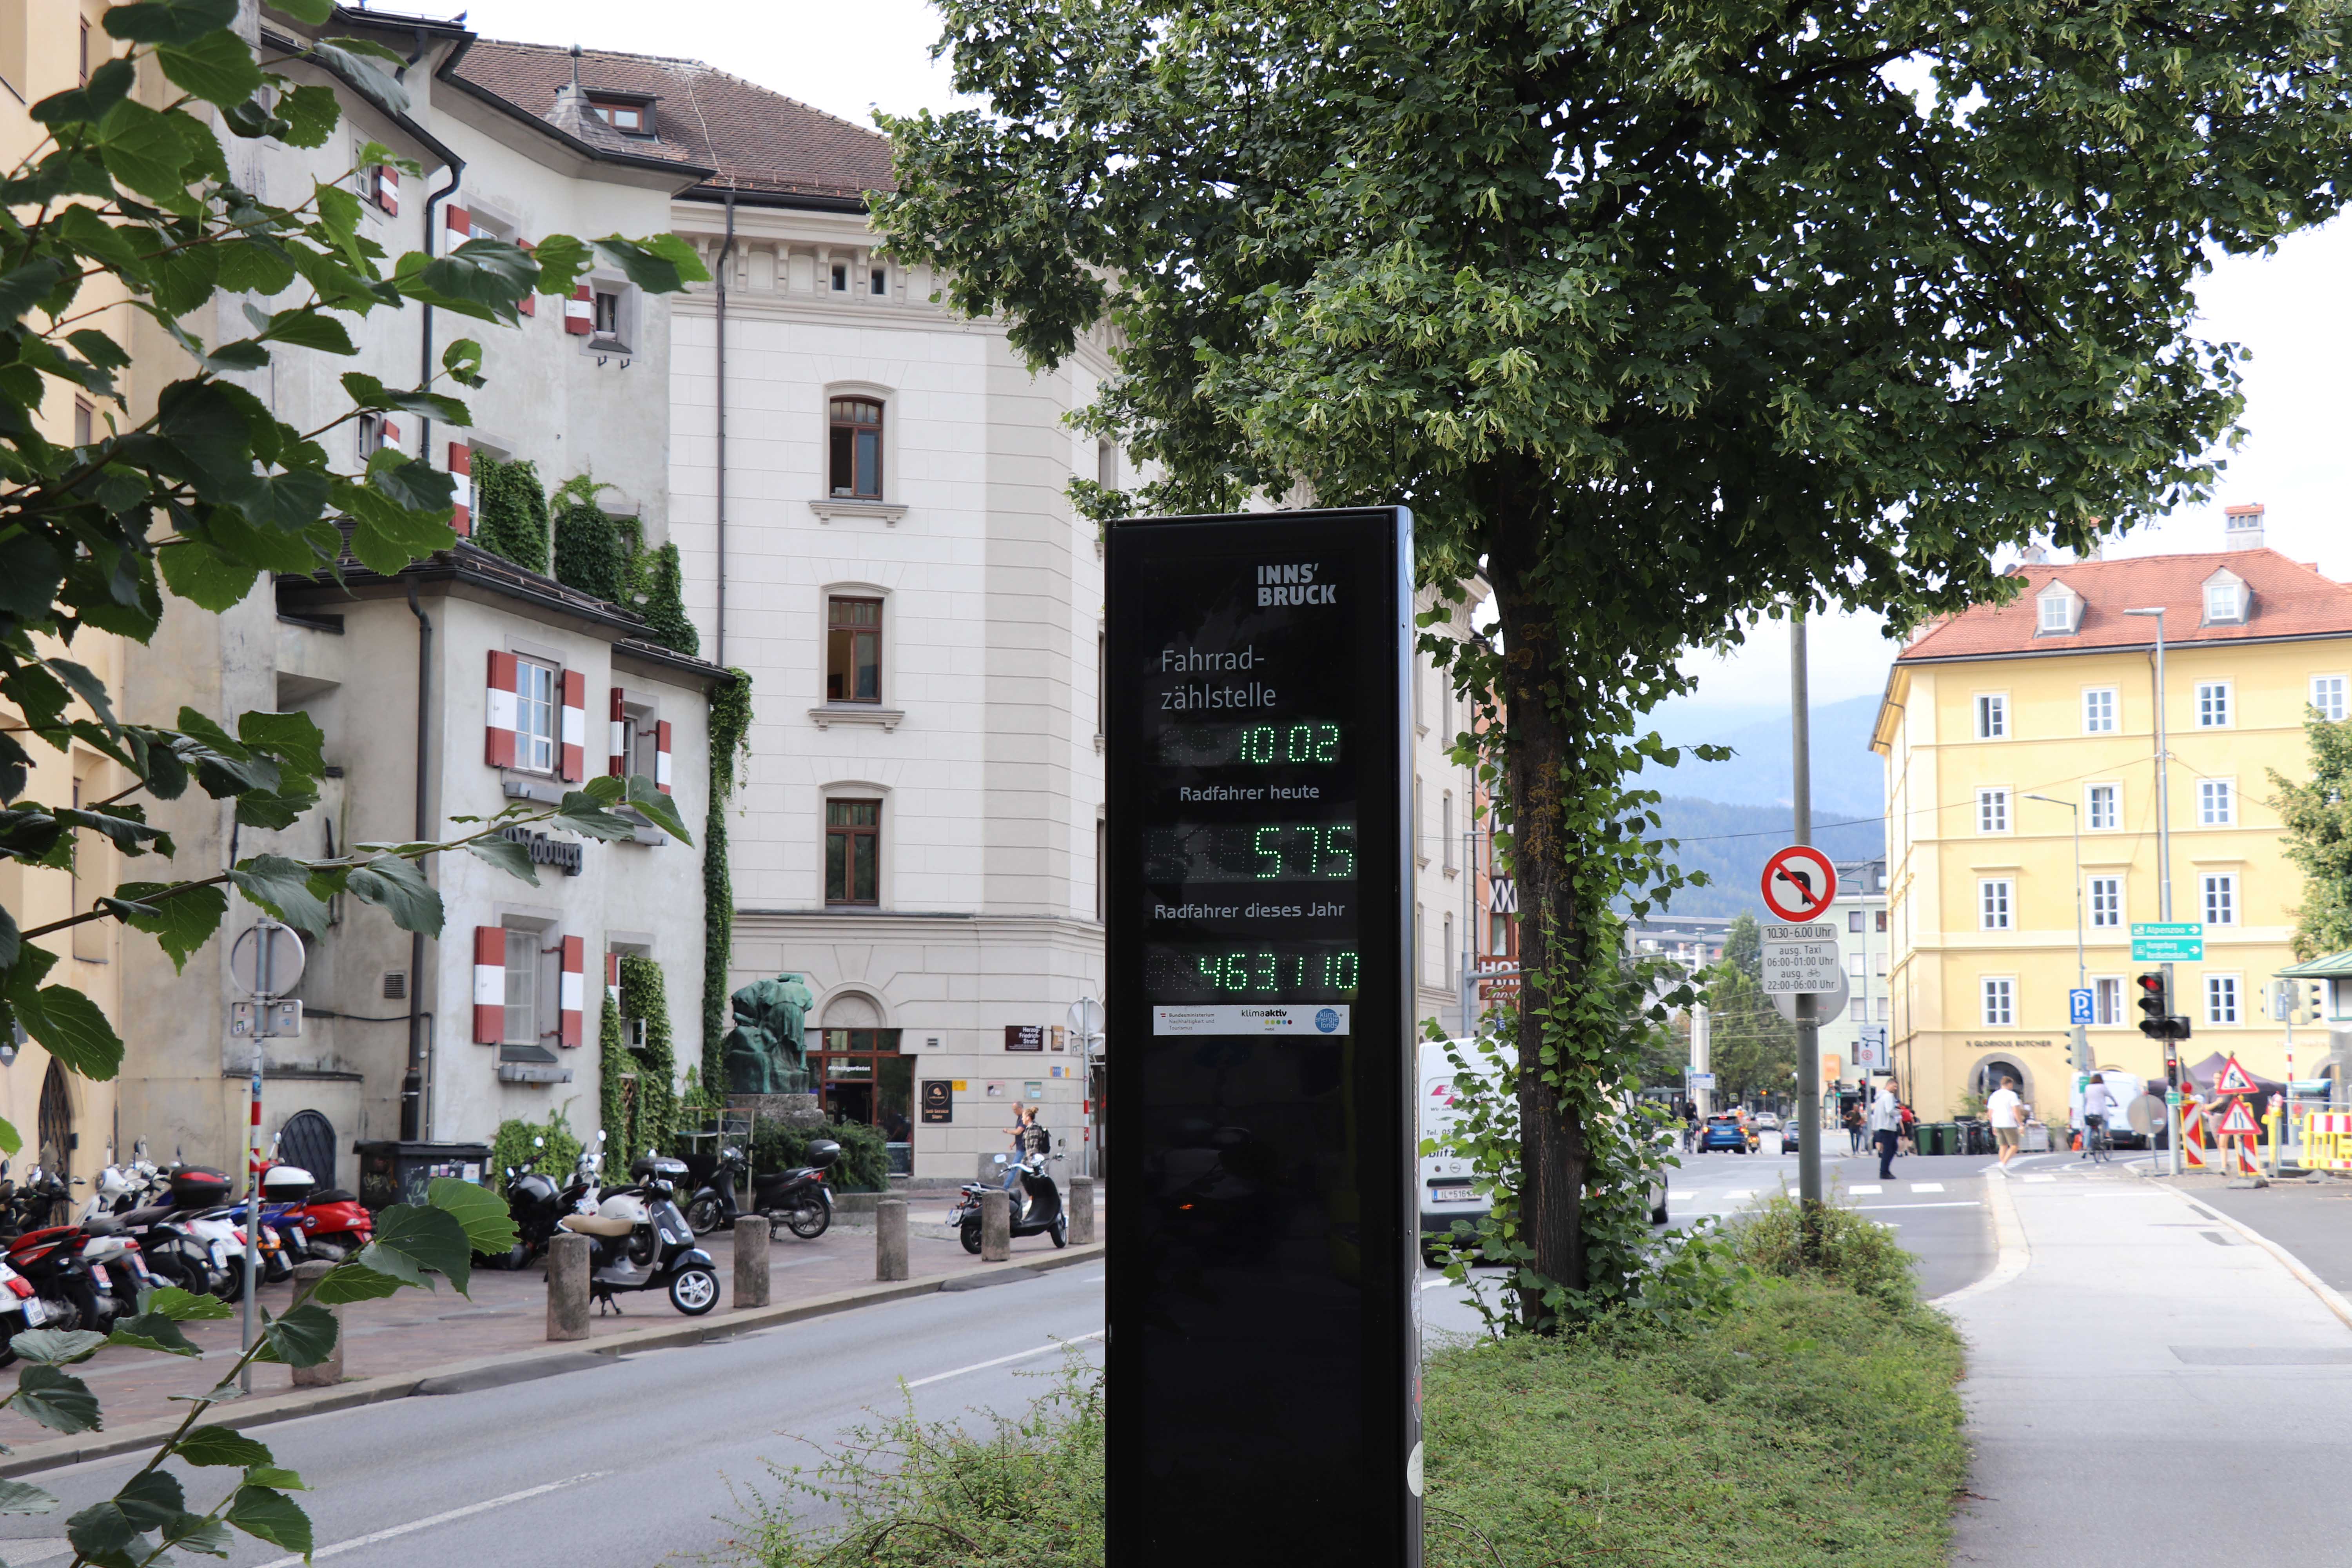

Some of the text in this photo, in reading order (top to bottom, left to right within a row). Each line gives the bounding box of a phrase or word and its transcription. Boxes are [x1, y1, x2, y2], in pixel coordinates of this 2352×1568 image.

[1258, 584, 1336, 606] BRUCK
[1161, 645, 1265, 672] Fahrrad-
[1161, 682, 1276, 710] zählstelle
[1180, 784, 1319, 801] Radfahrer heute
[1255, 826, 1353, 878] 575
[1155, 902, 1345, 919] Radfahrer dieses Jahr
[1815, 927, 1832, 937] Uhr
[2146, 926, 2186, 935] Alpenzoo
[1780, 944, 1822, 956] ausg. Taxi
[1767, 956, 1834, 967] 06:00-01:00 Uhr
[1781, 971, 1803, 979] ausg.
[1768, 980, 1835, 990] 22:00-06:00 Uhr
[2074, 996, 2089, 1016] P
